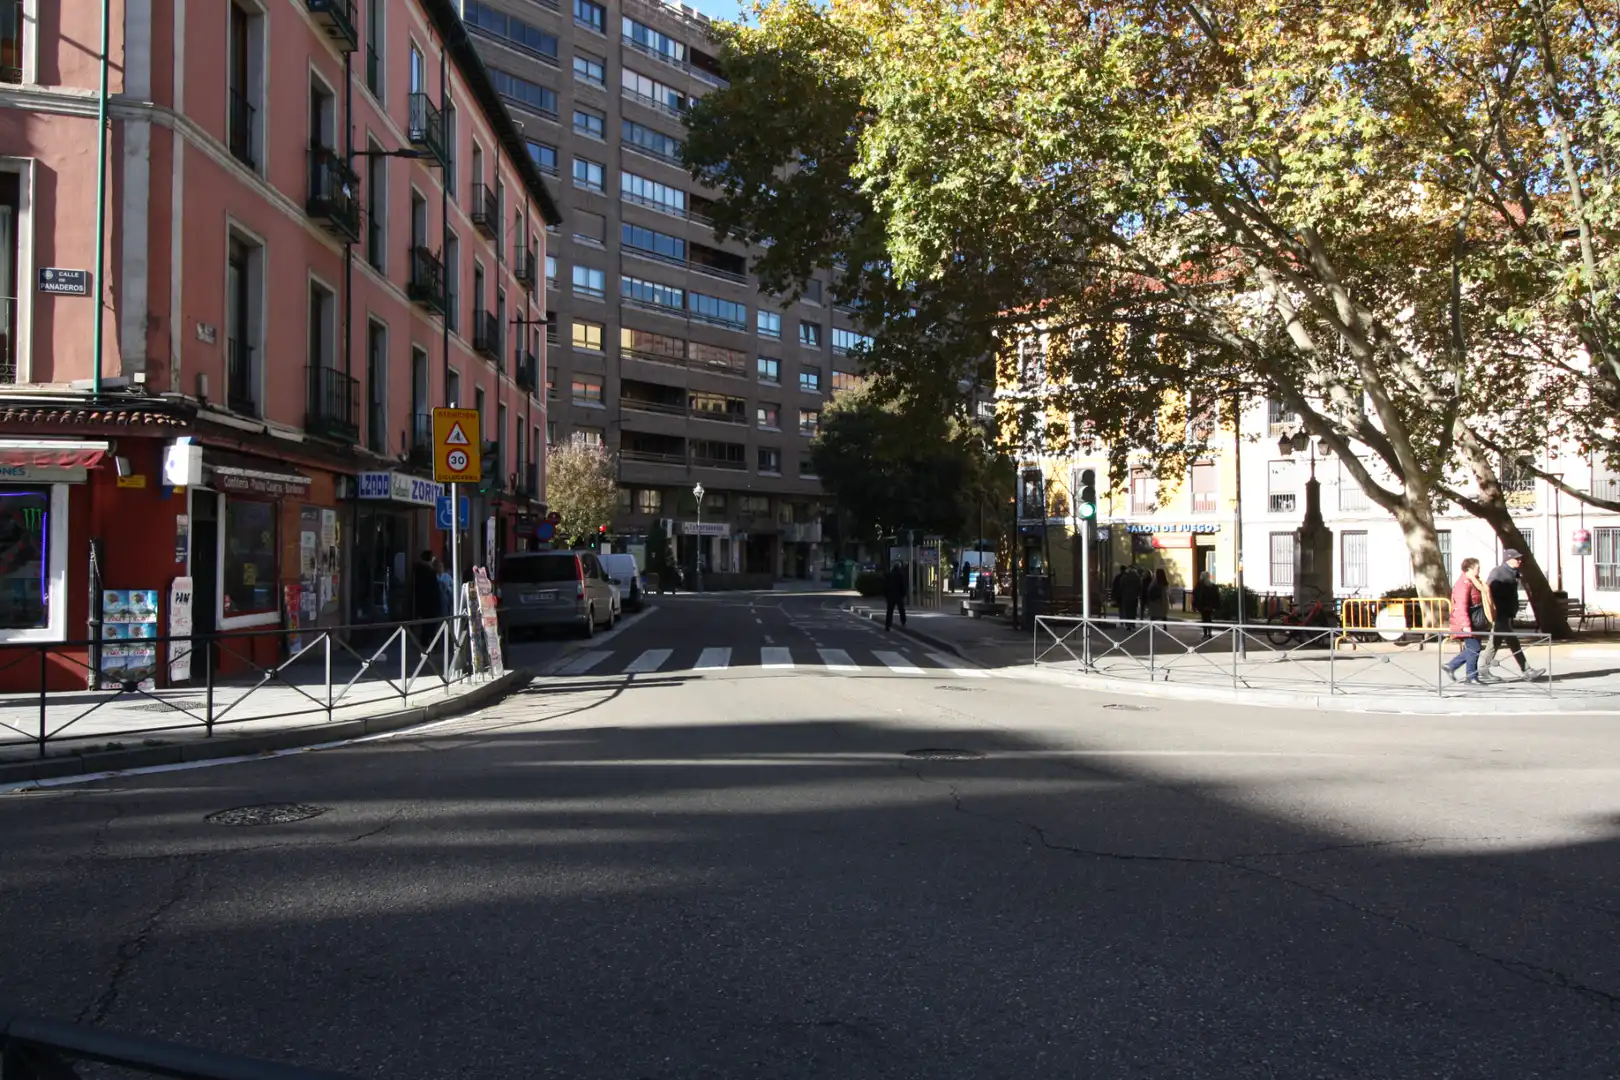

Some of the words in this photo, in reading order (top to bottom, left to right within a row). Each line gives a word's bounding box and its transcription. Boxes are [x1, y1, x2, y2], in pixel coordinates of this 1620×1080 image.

[40, 283, 83, 291] PANADEROS
[450, 456, 465, 465] 30
[0, 467, 26, 477] NES
[1163, 524, 1177, 533] DE
[1179, 524, 1221, 533] JUEGOS
